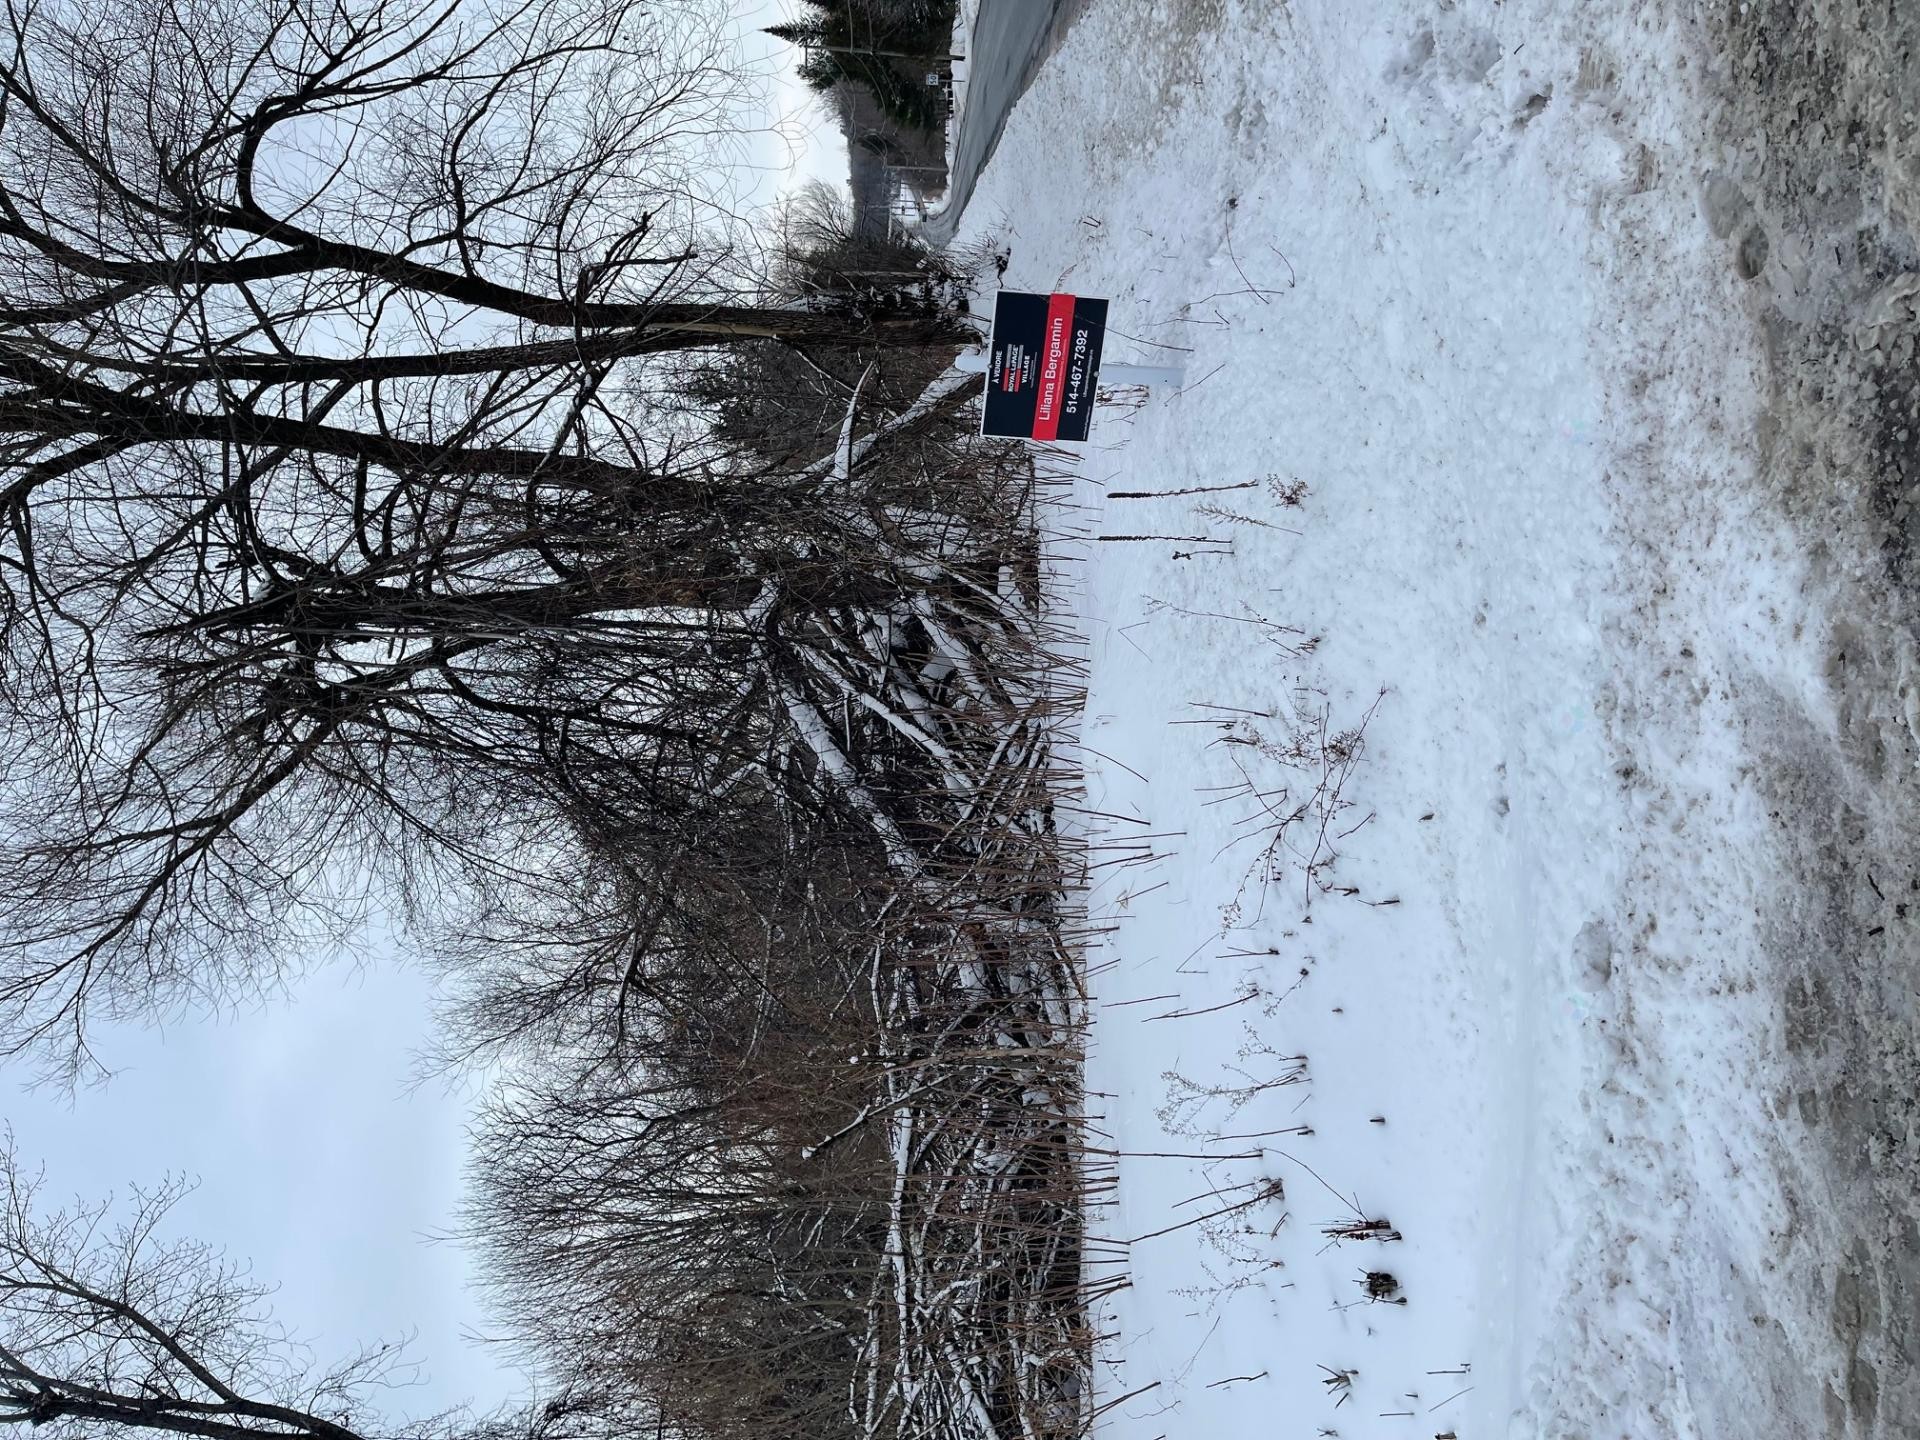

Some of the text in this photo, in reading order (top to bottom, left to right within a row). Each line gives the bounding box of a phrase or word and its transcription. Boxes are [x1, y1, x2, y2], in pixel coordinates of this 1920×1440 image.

[994, 351, 1002, 377] VENDRE
[1045, 318, 1063, 379] Bergamin
[1022, 355, 1030, 383] VILLAGE
[1066, 330, 1088, 413] 514-467-7392
[1039, 383, 1055, 420] Liliana
